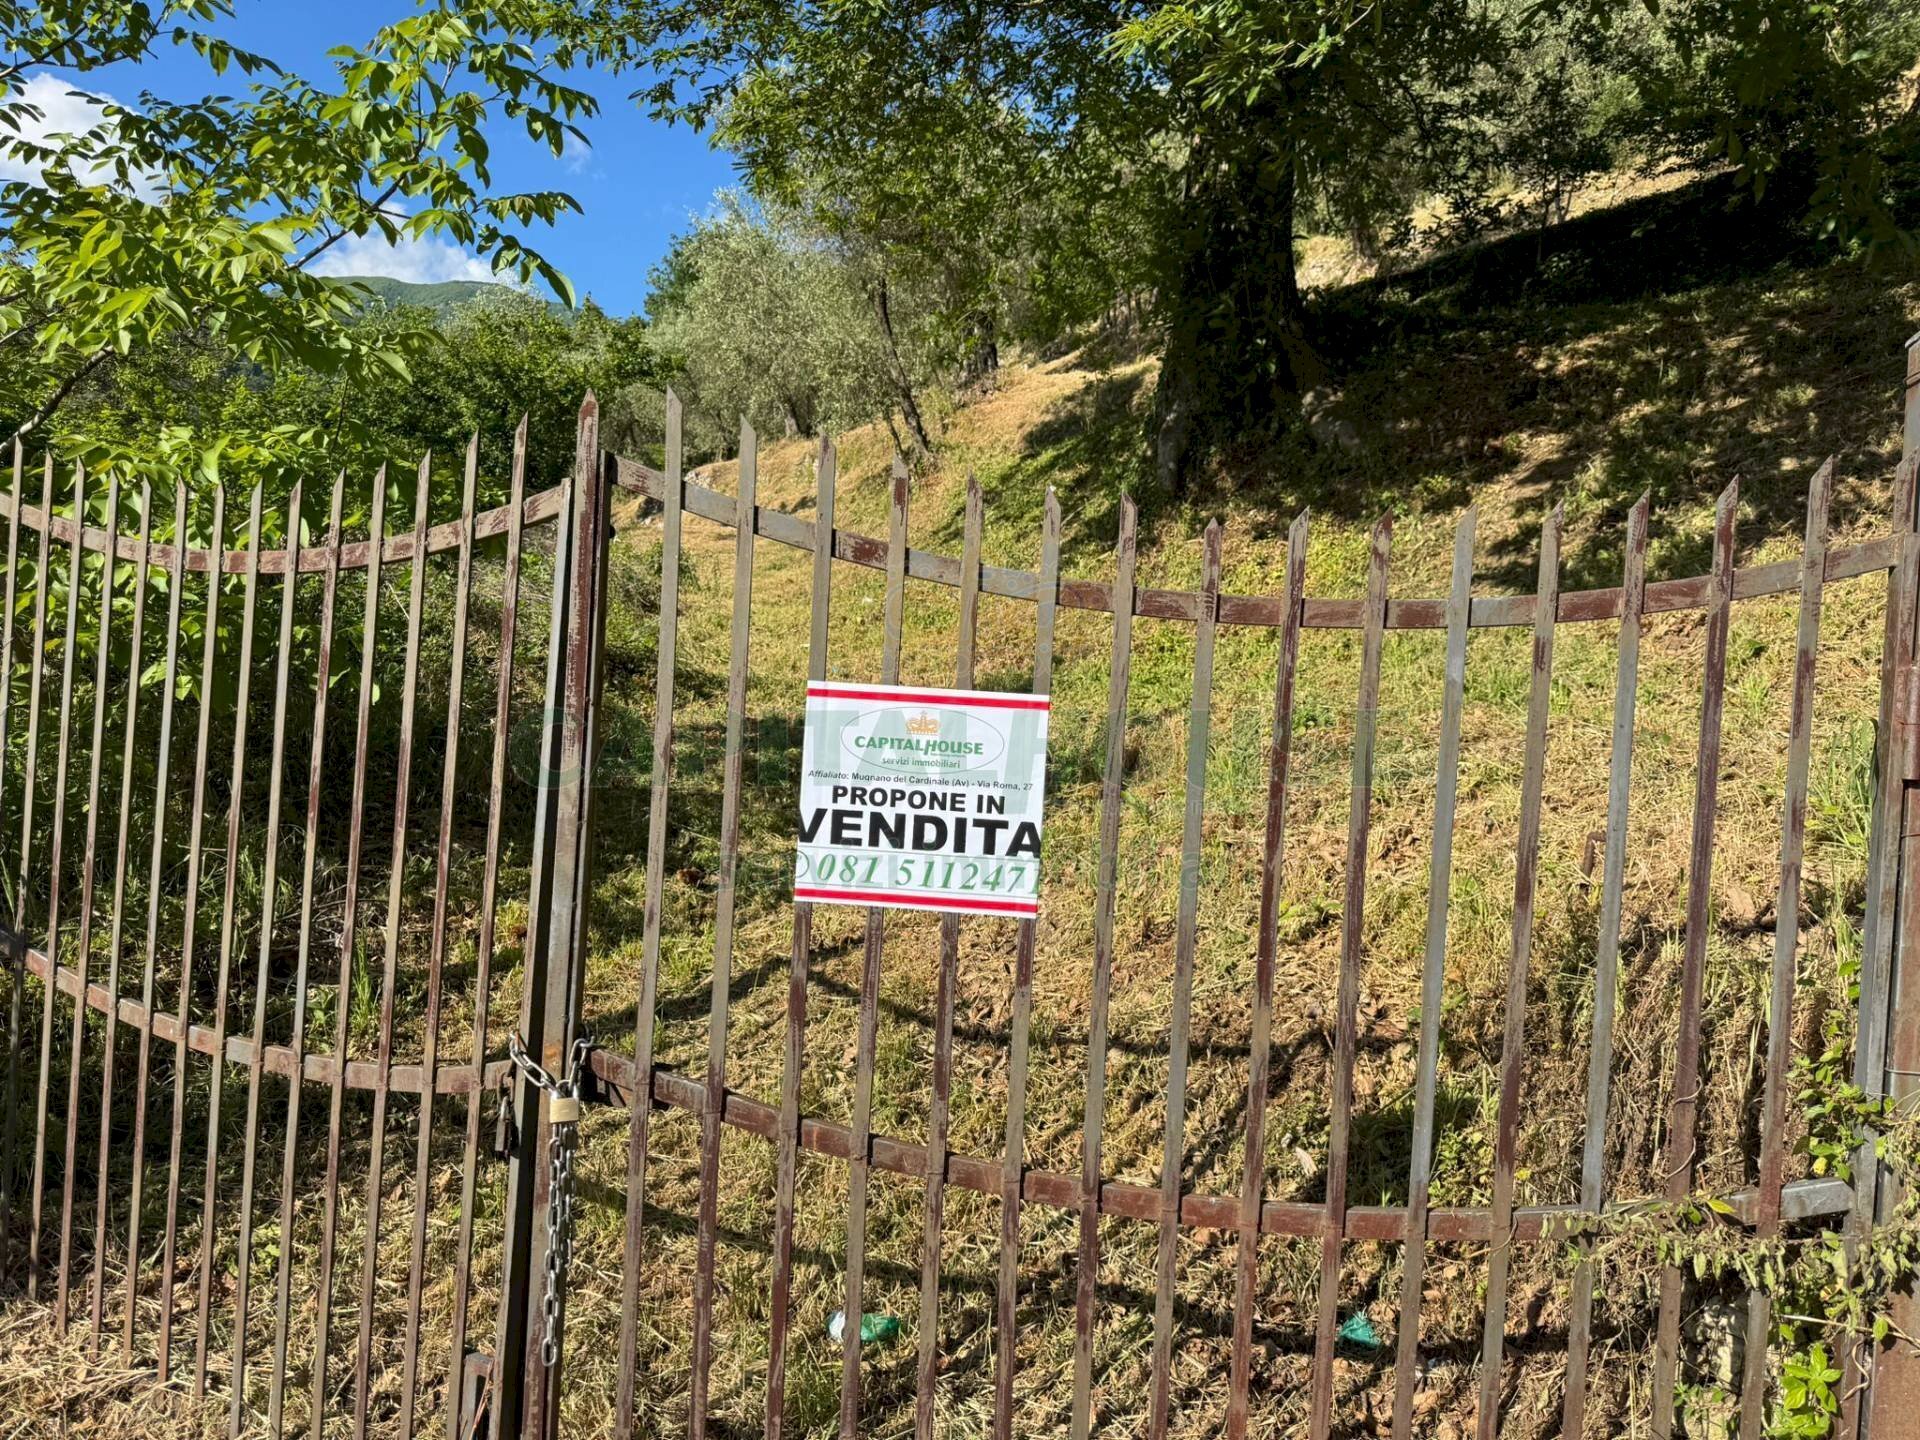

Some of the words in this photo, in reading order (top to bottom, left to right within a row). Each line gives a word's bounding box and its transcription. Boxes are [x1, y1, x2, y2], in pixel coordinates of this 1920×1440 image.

[854, 735, 983, 756] CAPITALHOUSE
[882, 756, 910, 766] servizi
[911, 756, 961, 769] immobiliari
[893, 775, 906, 784] del
[909, 775, 950, 786] Cardinale
[952, 778, 970, 788] (Av)
[977, 779, 990, 788] Via
[993, 780, 1021, 791] Roma,
[1023, 782, 1033, 791] 27
[832, 785, 966, 813] PROPONE
[976, 794, 1006, 815] IN
[798, 808, 1041, 859] VENDITA
[817, 853, 879, 885] 081
